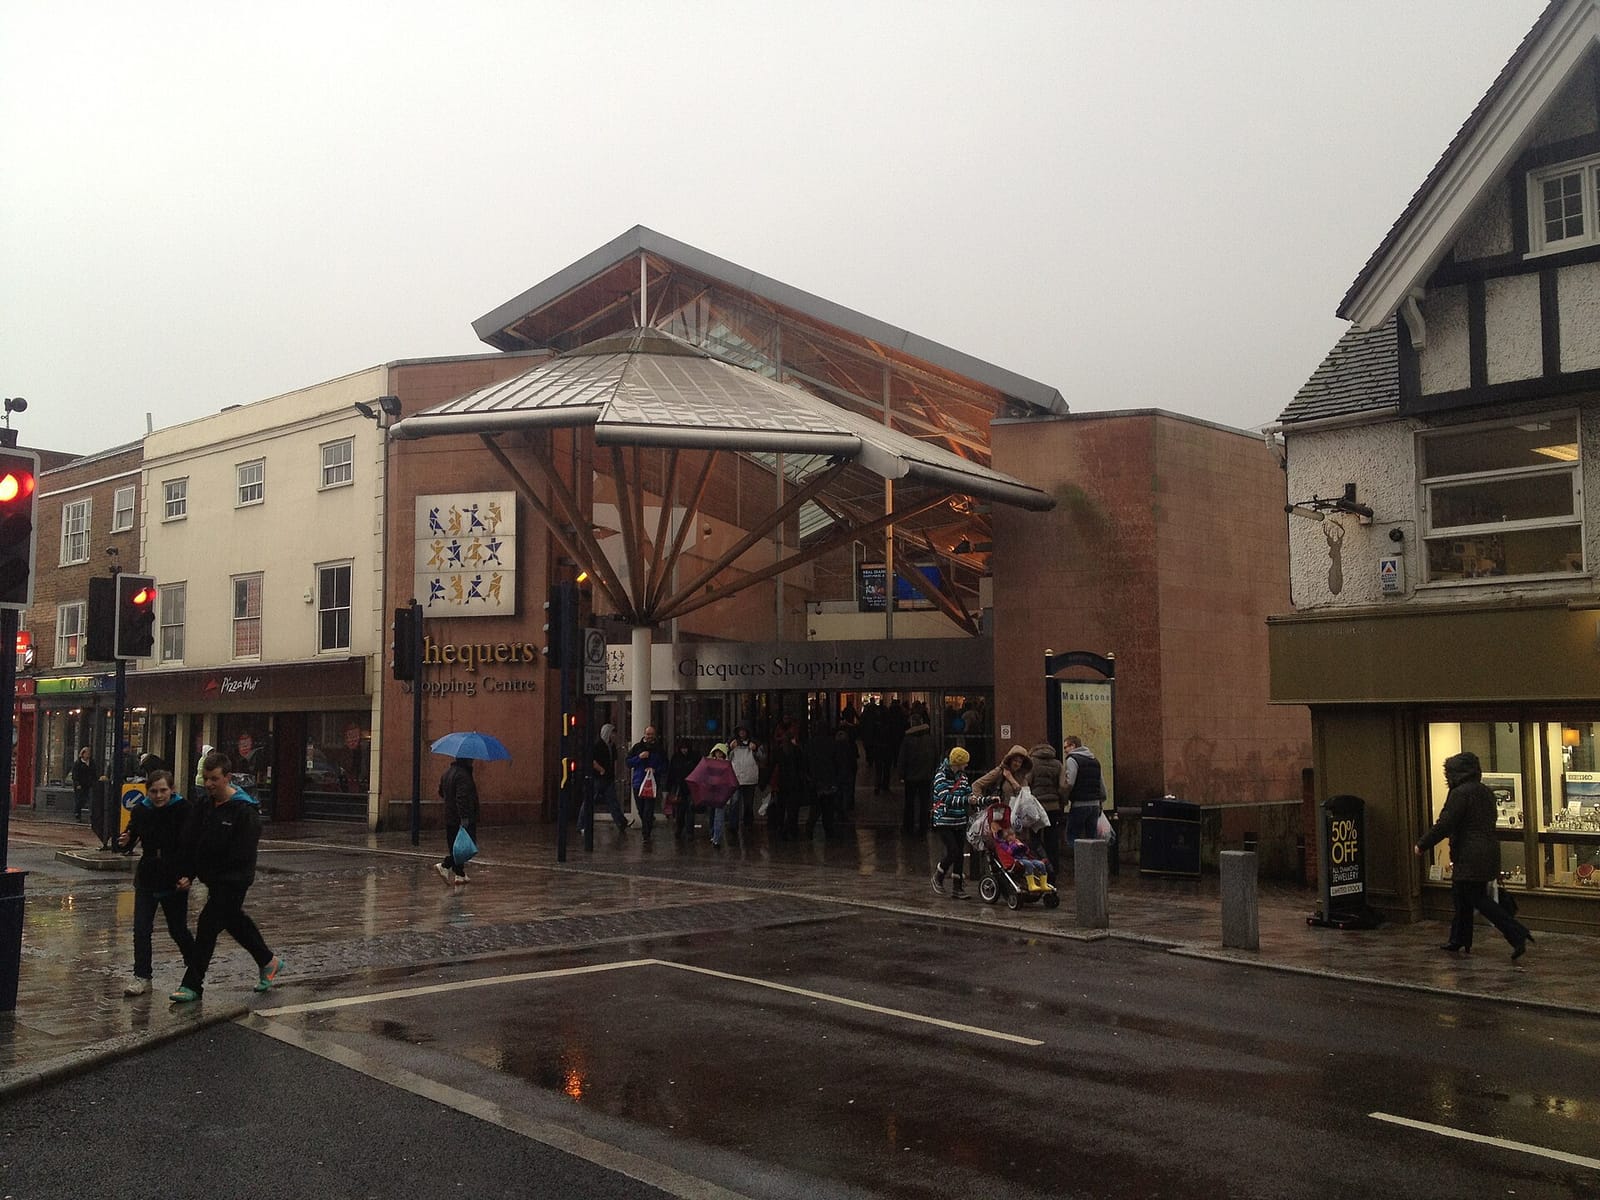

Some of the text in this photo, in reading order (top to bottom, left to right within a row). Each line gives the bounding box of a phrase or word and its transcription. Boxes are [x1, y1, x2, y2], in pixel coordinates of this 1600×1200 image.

[421, 635, 535, 672] hequers
[679, 655, 940, 681] Chequers Shopping Centre
[220, 676, 261, 694] Pizza Hut
[483, 676, 535, 692] Centre
[587, 683, 604, 692] ENDS
[1062, 692, 1110, 701] Maidstone
[1331, 819, 1358, 842] 50%
[1331, 841, 1358, 865] OFF
[1332, 871, 1359, 883] JEWELLERY
